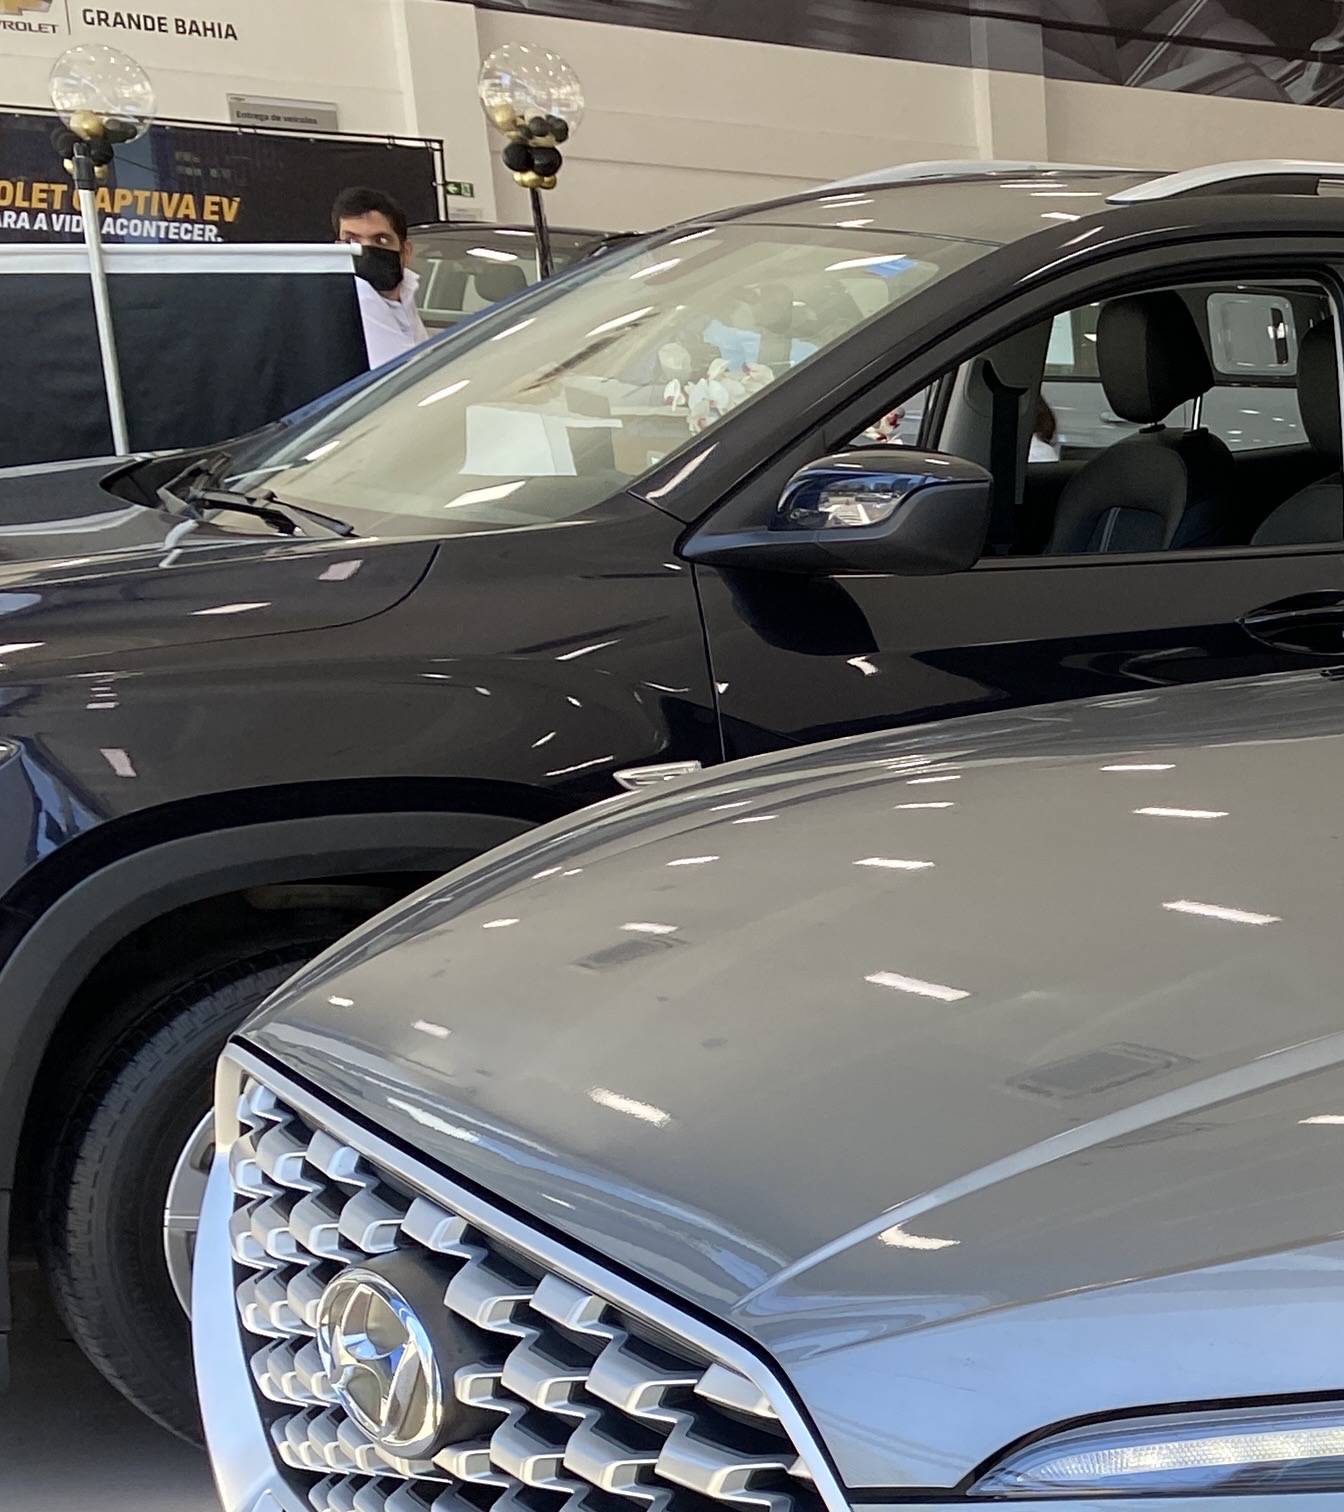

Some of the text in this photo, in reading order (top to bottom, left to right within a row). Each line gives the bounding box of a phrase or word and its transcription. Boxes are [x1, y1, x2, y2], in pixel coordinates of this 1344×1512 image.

[82, 8, 238, 41] GRANDE BAHIA
[236, 110, 269, 122] Entrega
[0, 180, 68, 210] OLET
[203, 195, 240, 222] EV
[33, 212, 48, 231] A
[51, 213, 84, 233] VID
[101, 216, 223, 242] ACONTECER.
